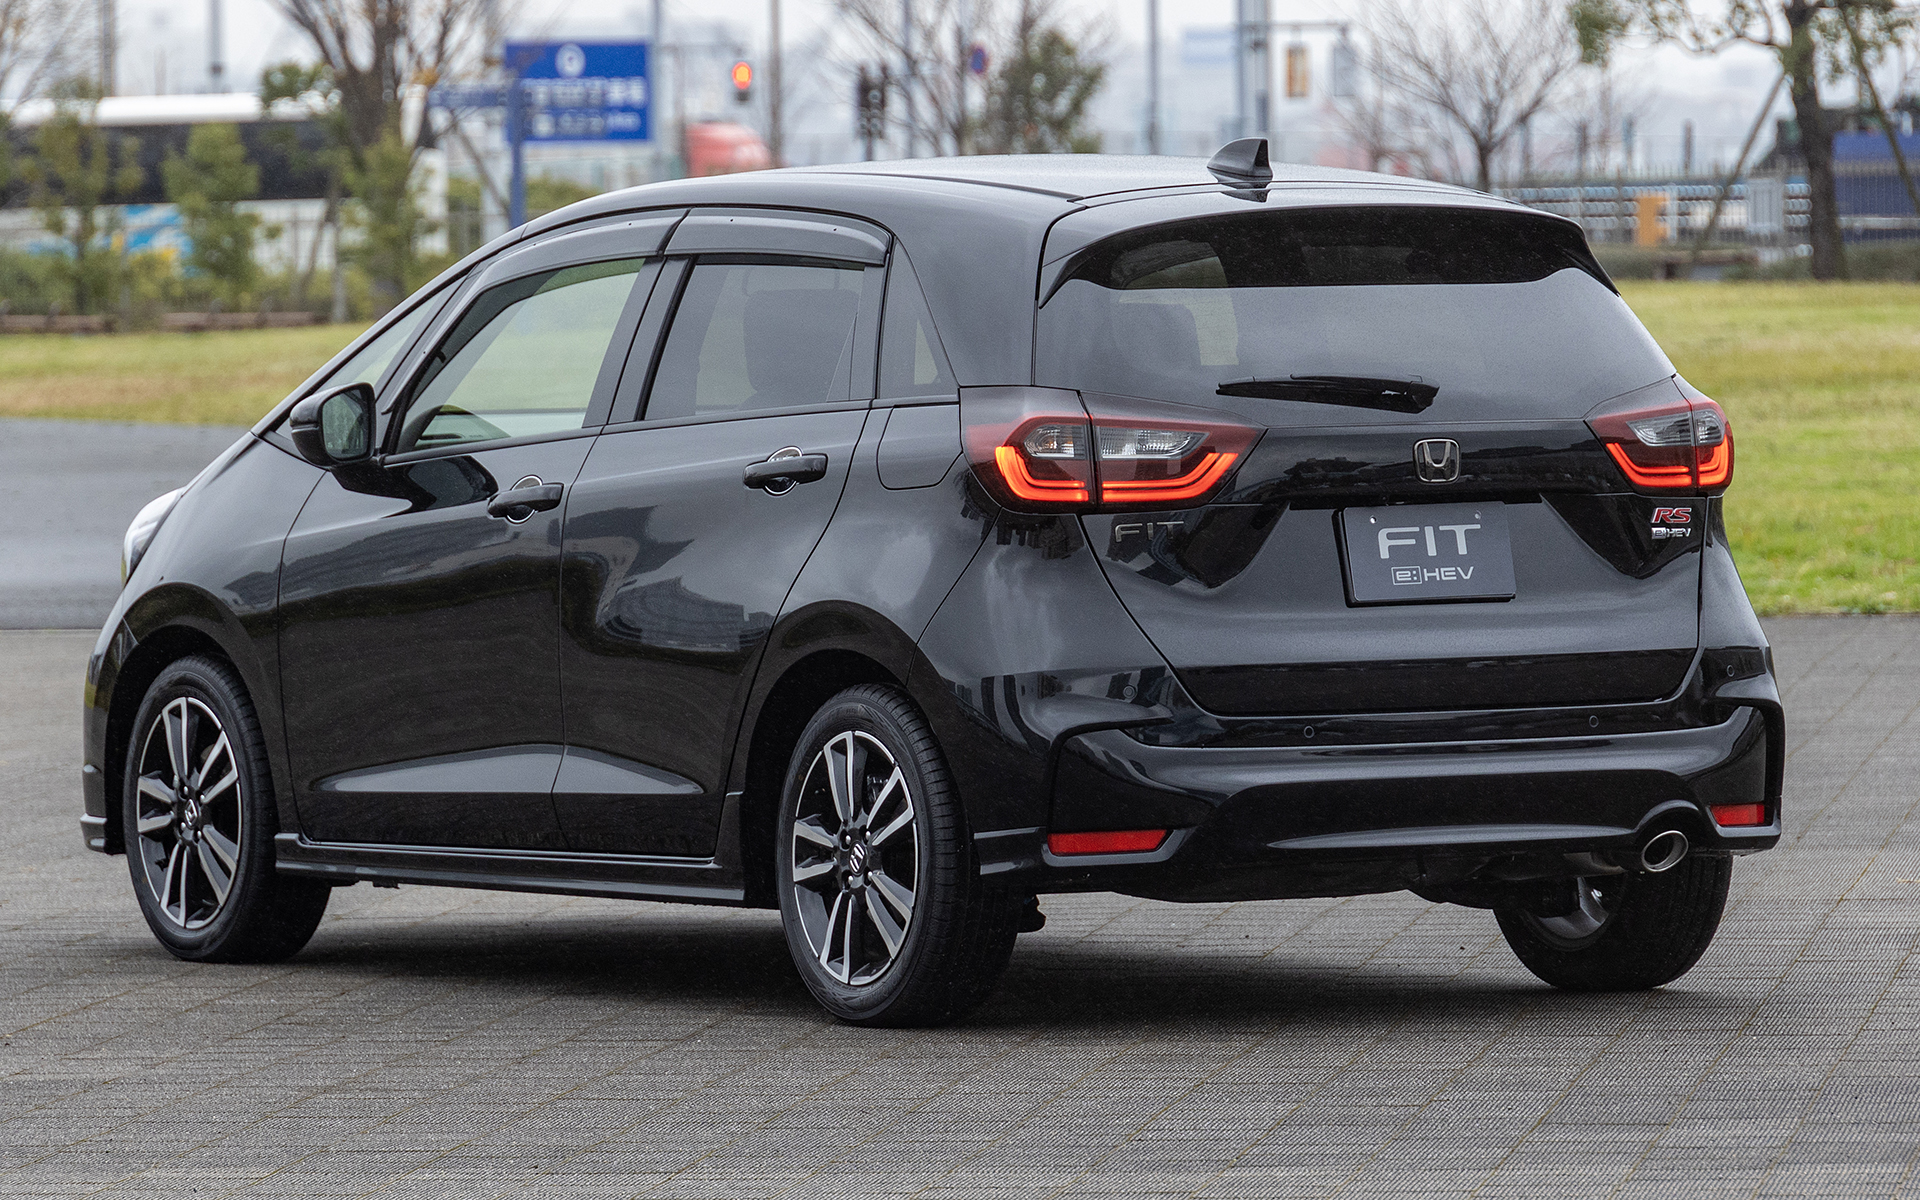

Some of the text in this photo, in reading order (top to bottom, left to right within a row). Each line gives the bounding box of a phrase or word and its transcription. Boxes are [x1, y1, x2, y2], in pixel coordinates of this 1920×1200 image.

[1651, 507, 1692, 523] RS
[1115, 521, 1184, 542] FIT
[1378, 524, 1481, 559] FIT
[1391, 566, 1474, 585] e:HEV
